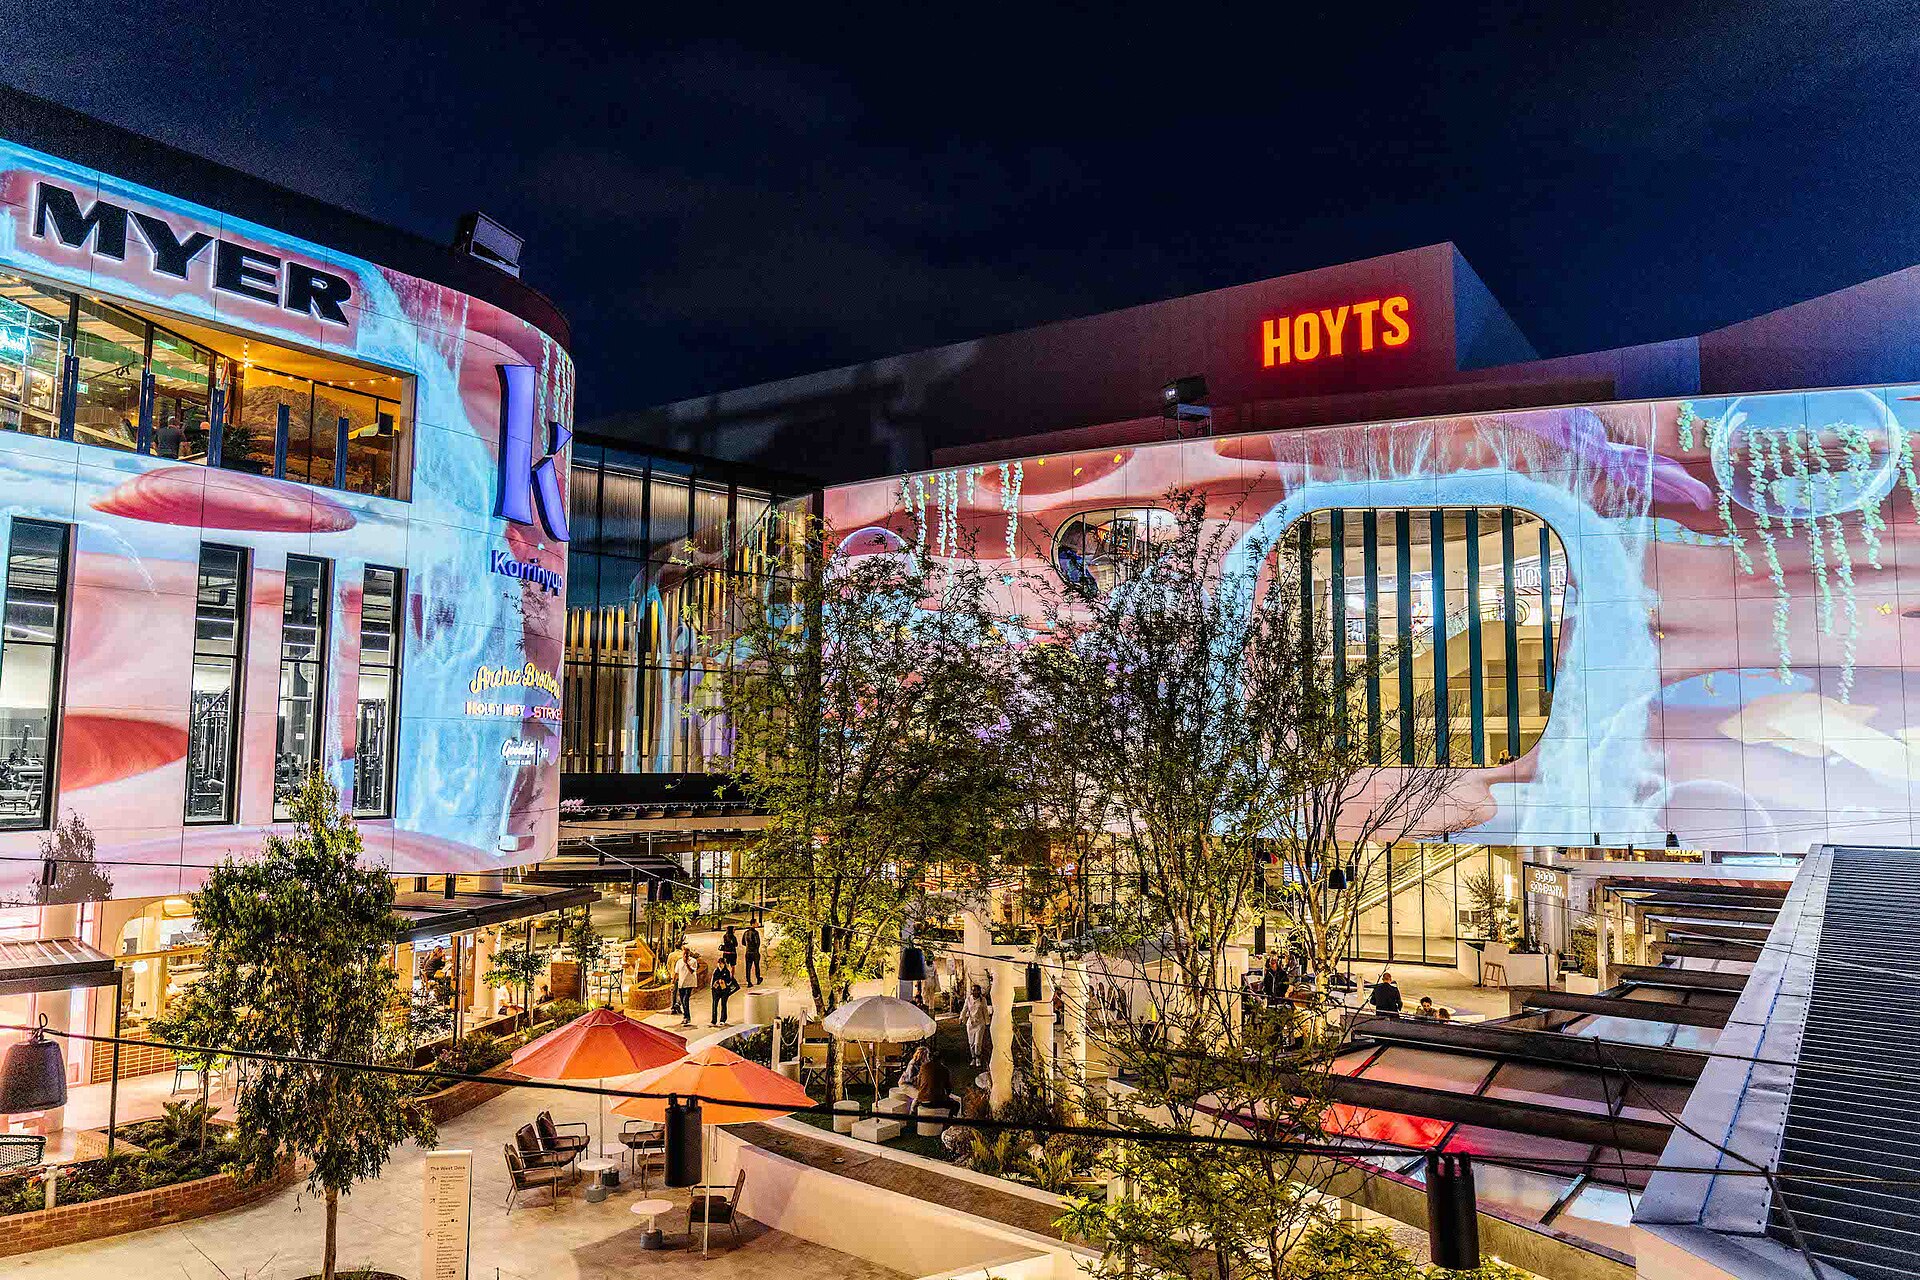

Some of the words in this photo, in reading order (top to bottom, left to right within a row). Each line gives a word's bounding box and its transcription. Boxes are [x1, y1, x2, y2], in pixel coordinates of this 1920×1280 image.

[33, 181, 351, 327] MYER
[1262, 295, 1410, 367] HOYTS
[490, 549, 563, 597] Karrinyup
[469, 664, 522, 694] Archie
[1534, 869, 1557, 884] GOOD
